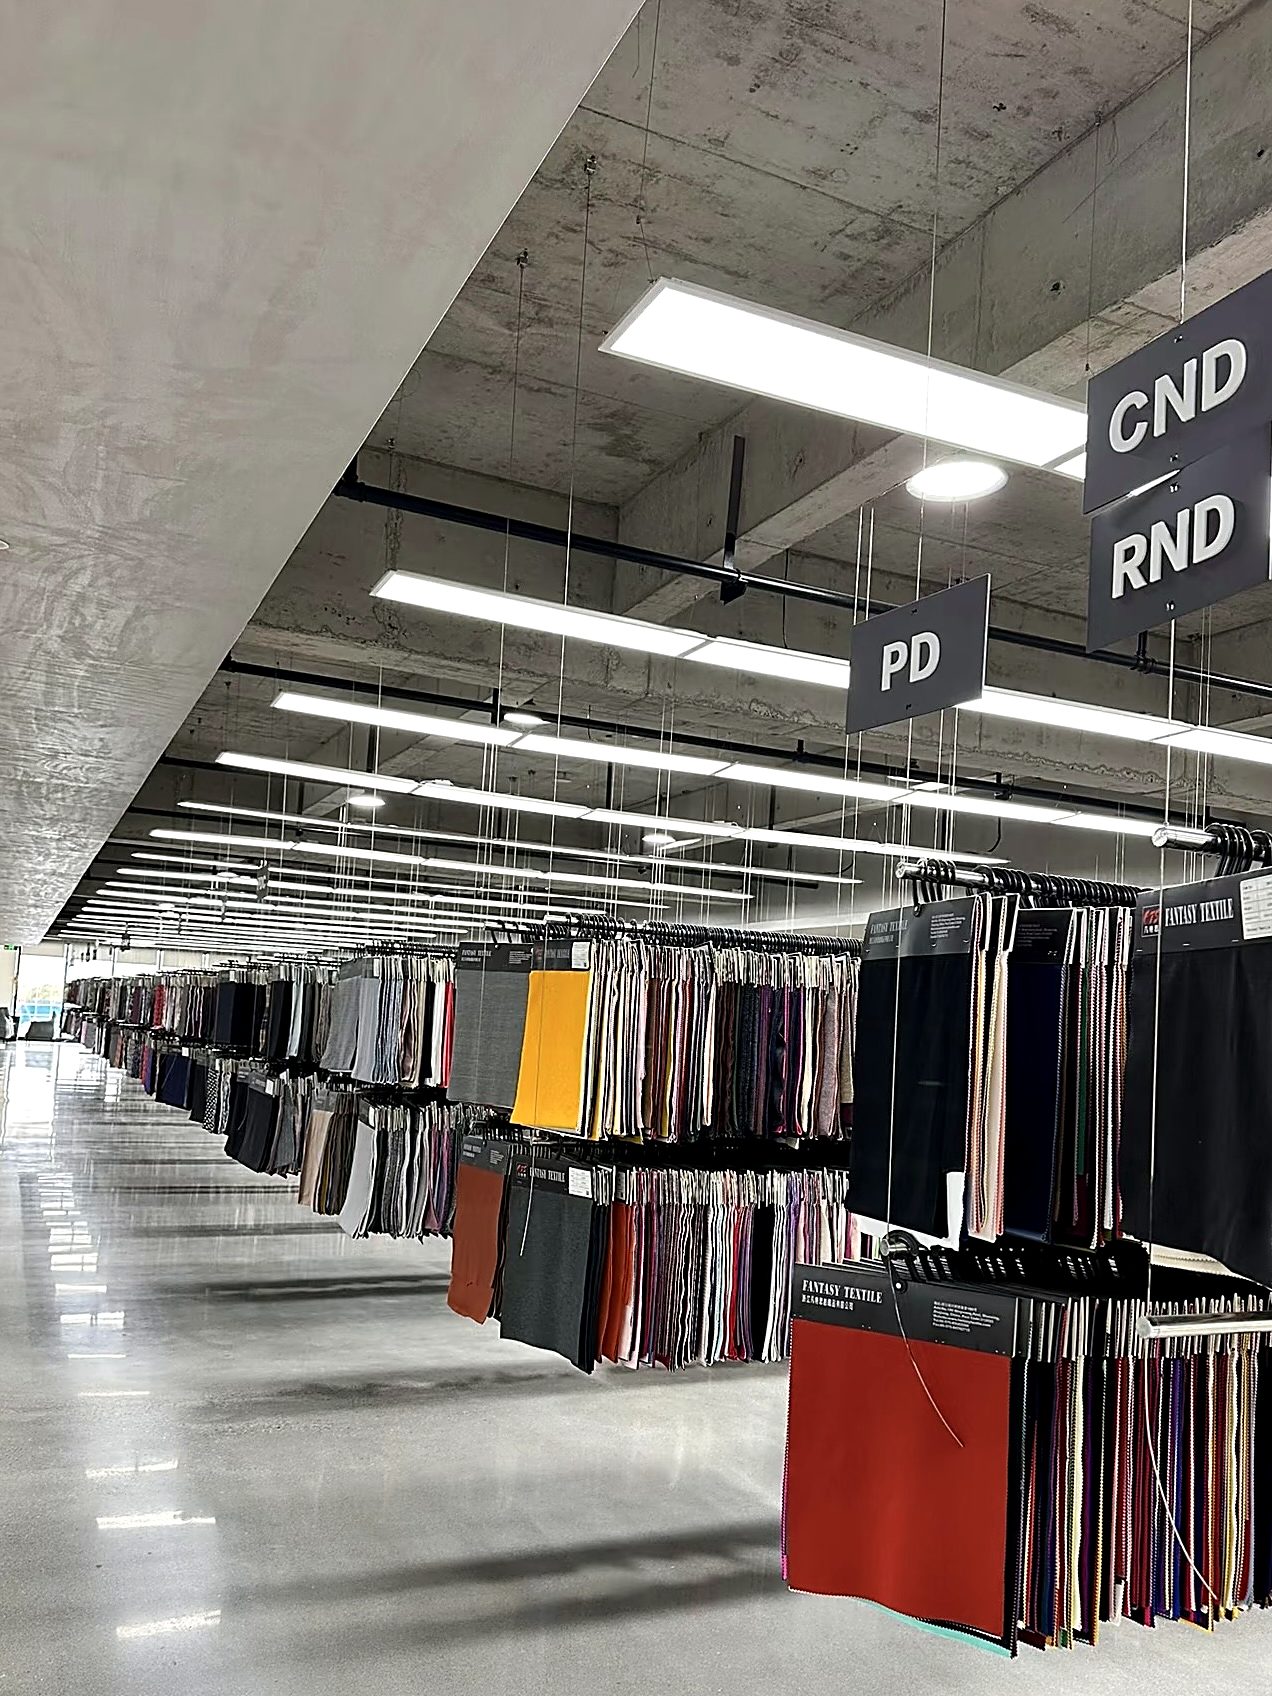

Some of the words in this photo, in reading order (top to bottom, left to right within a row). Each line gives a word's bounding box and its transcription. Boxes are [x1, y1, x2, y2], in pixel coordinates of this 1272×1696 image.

[1108, 338, 1247, 454] CND
[1111, 494, 1236, 600] RND
[880, 631, 941, 692] PD
[1164, 903, 1198, 927] FANTASY
[1199, 898, 1234, 922] TEXTILE
[802, 1279, 841, 1297] FANTASY
[844, 1286, 883, 1304] TEXTILE
